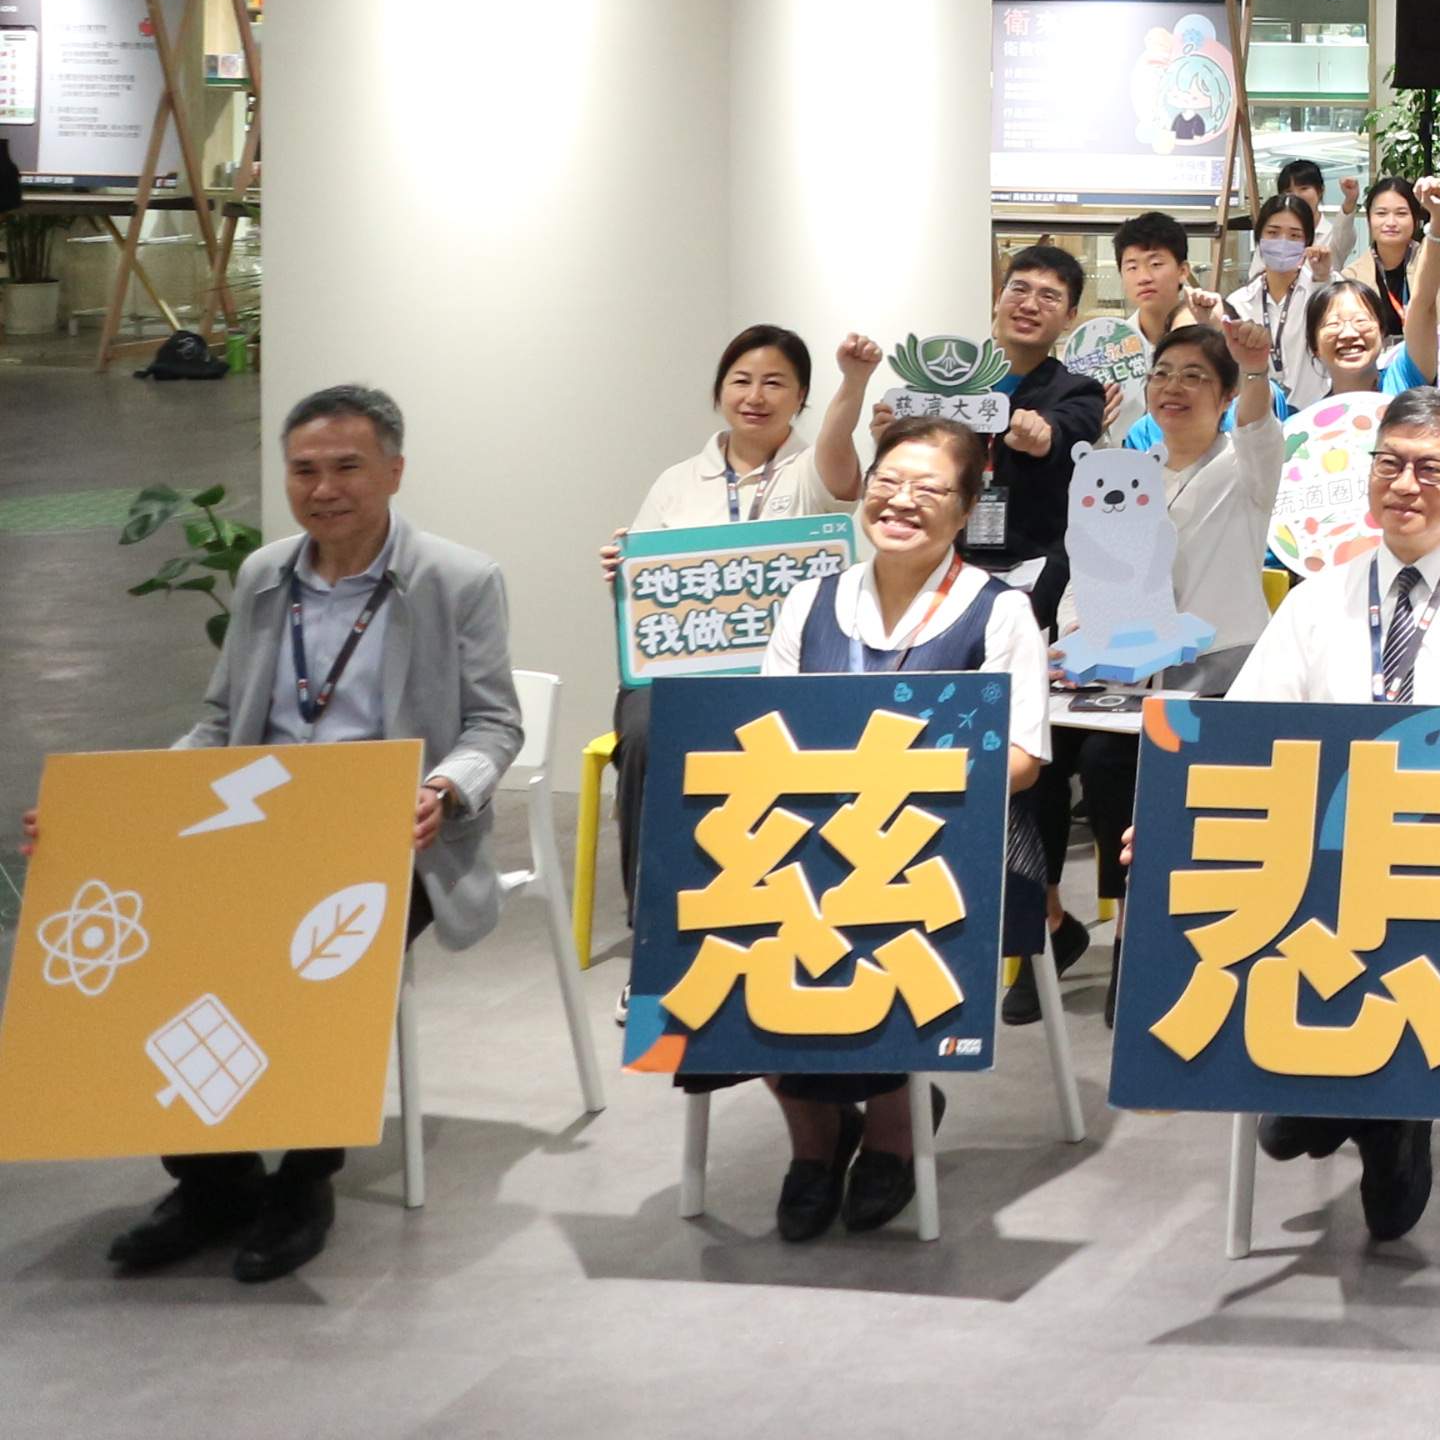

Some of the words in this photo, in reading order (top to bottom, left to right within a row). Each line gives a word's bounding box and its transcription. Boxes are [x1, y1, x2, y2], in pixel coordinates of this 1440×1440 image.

[636, 549, 842, 603] 地球的未來
[660, 709, 970, 1035] 慈
